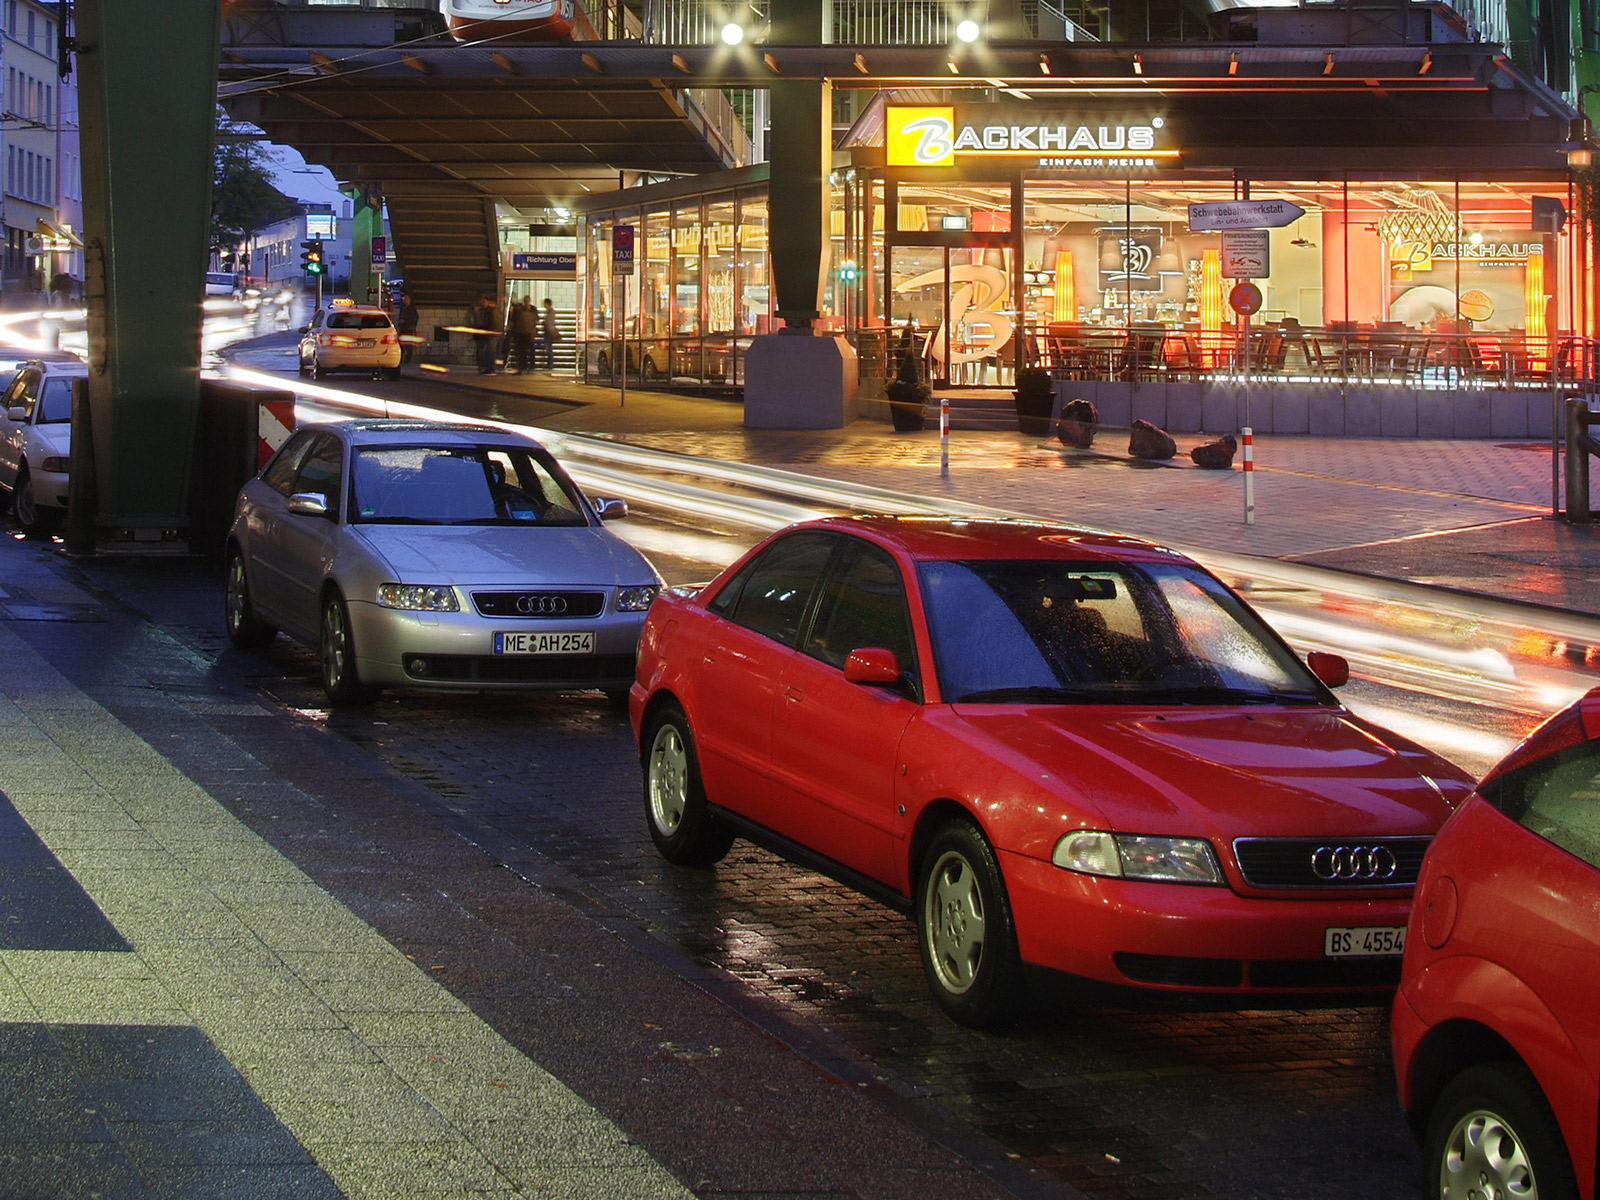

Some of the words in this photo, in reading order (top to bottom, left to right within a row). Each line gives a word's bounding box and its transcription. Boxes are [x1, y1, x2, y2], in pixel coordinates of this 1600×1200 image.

[901, 116, 1154, 162] BACKHAUS
[1039, 158, 1103, 167] EINFACH
[1107, 158, 1154, 167] HEISS
[1192, 204, 1284, 218] Schwebebahnwerkstatt
[1240, 216, 1269, 224] Ausfahrt
[615, 250, 632, 259] TAXI
[526, 256, 558, 265] Richtung
[505, 636, 526, 651] ME
